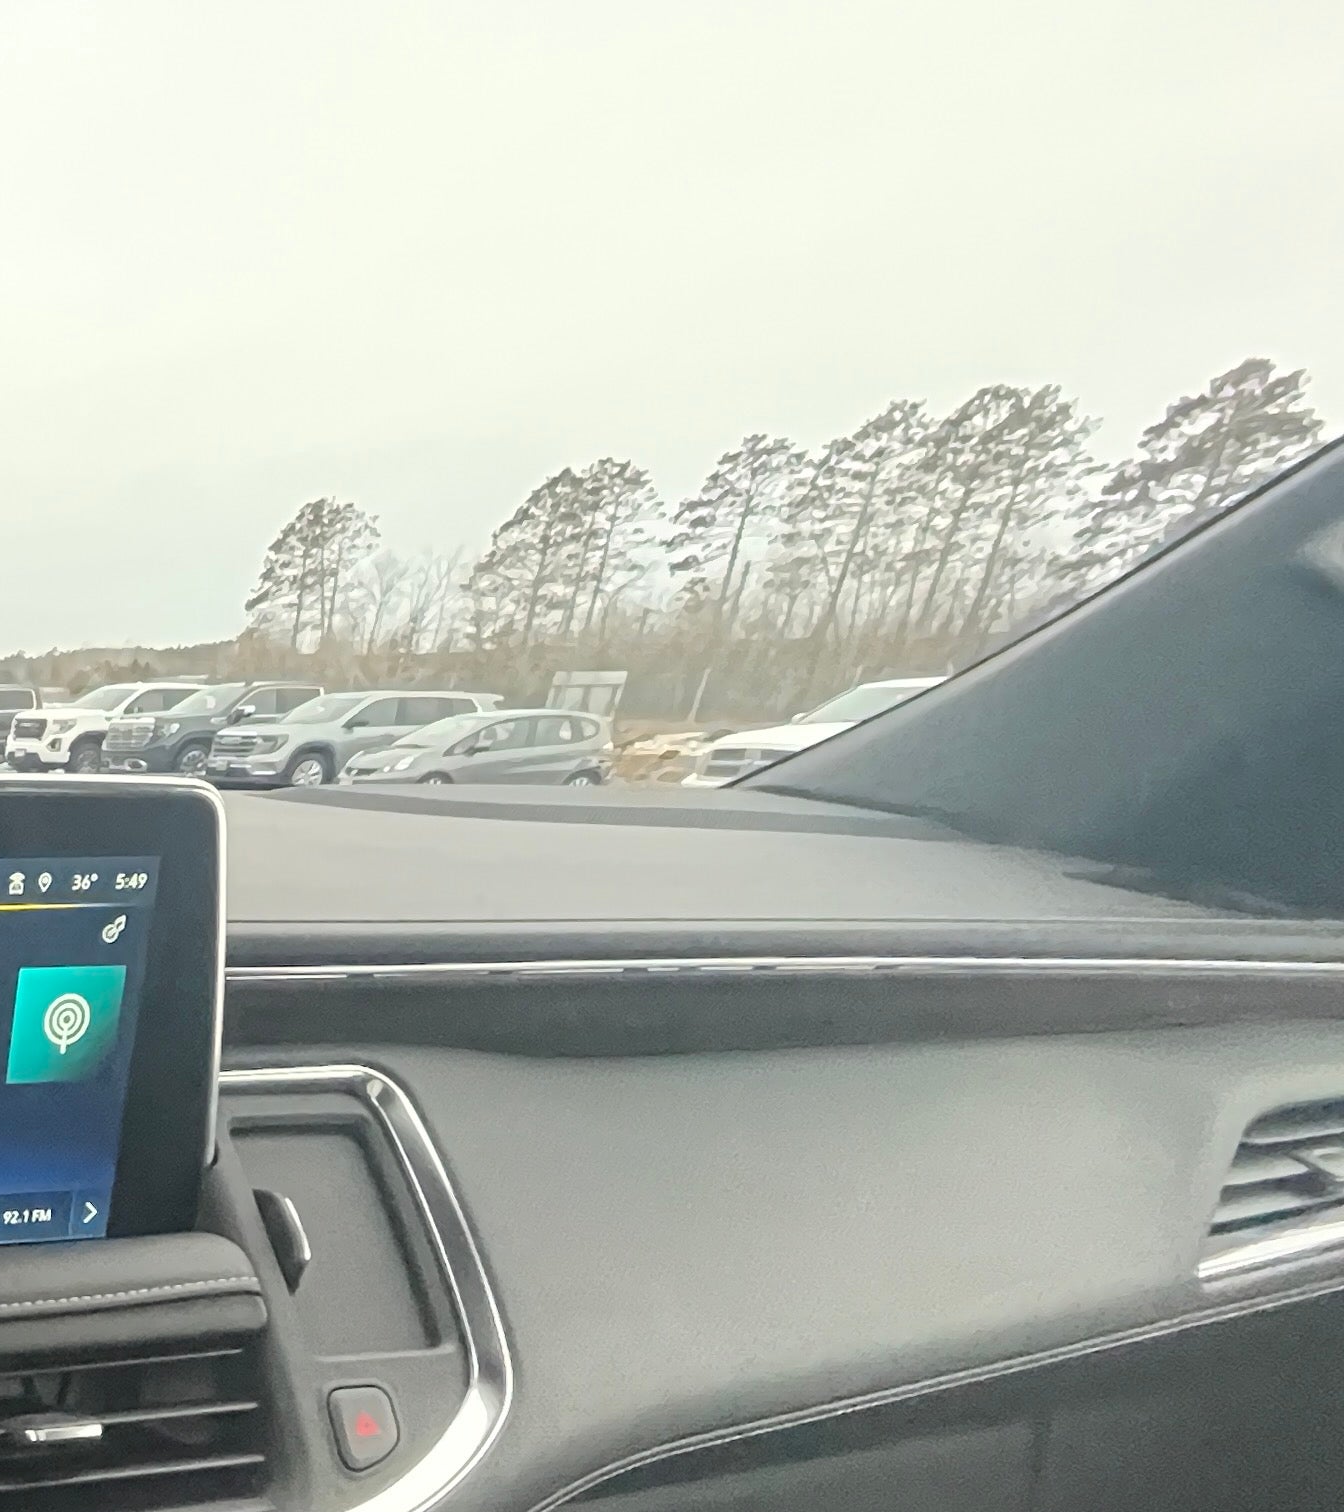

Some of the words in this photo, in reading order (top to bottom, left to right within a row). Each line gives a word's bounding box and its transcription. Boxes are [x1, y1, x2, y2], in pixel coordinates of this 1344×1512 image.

[115, 872, 148, 891] 5:49
[3, 1210, 29, 1225] 92.1
[31, 1208, 52, 1223] FM
